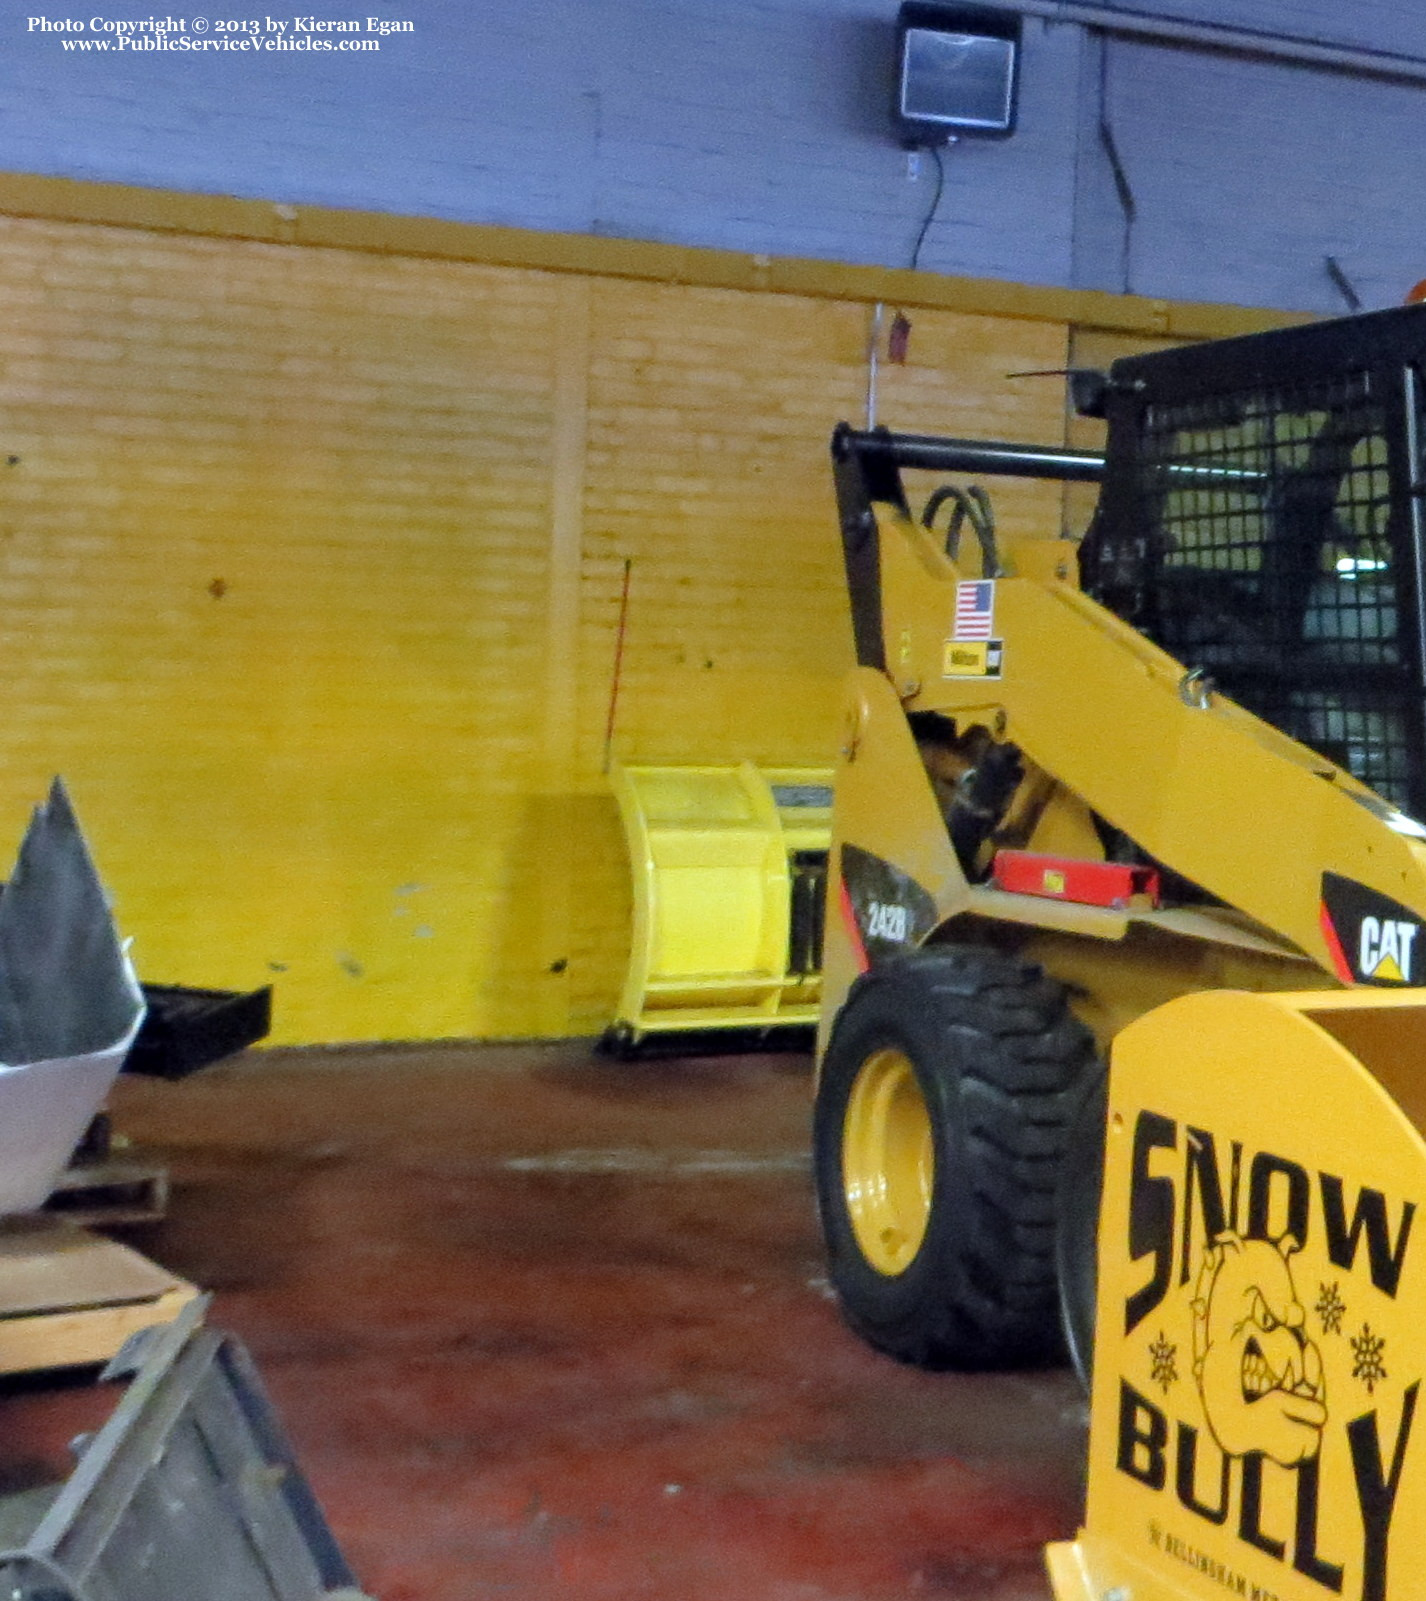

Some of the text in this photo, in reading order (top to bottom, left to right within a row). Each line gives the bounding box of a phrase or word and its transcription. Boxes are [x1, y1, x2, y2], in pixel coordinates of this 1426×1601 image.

[1359, 915, 1420, 982] CAT
[1124, 1108, 1418, 1337] SNOW
[1115, 1376, 1423, 1601] BULLY
